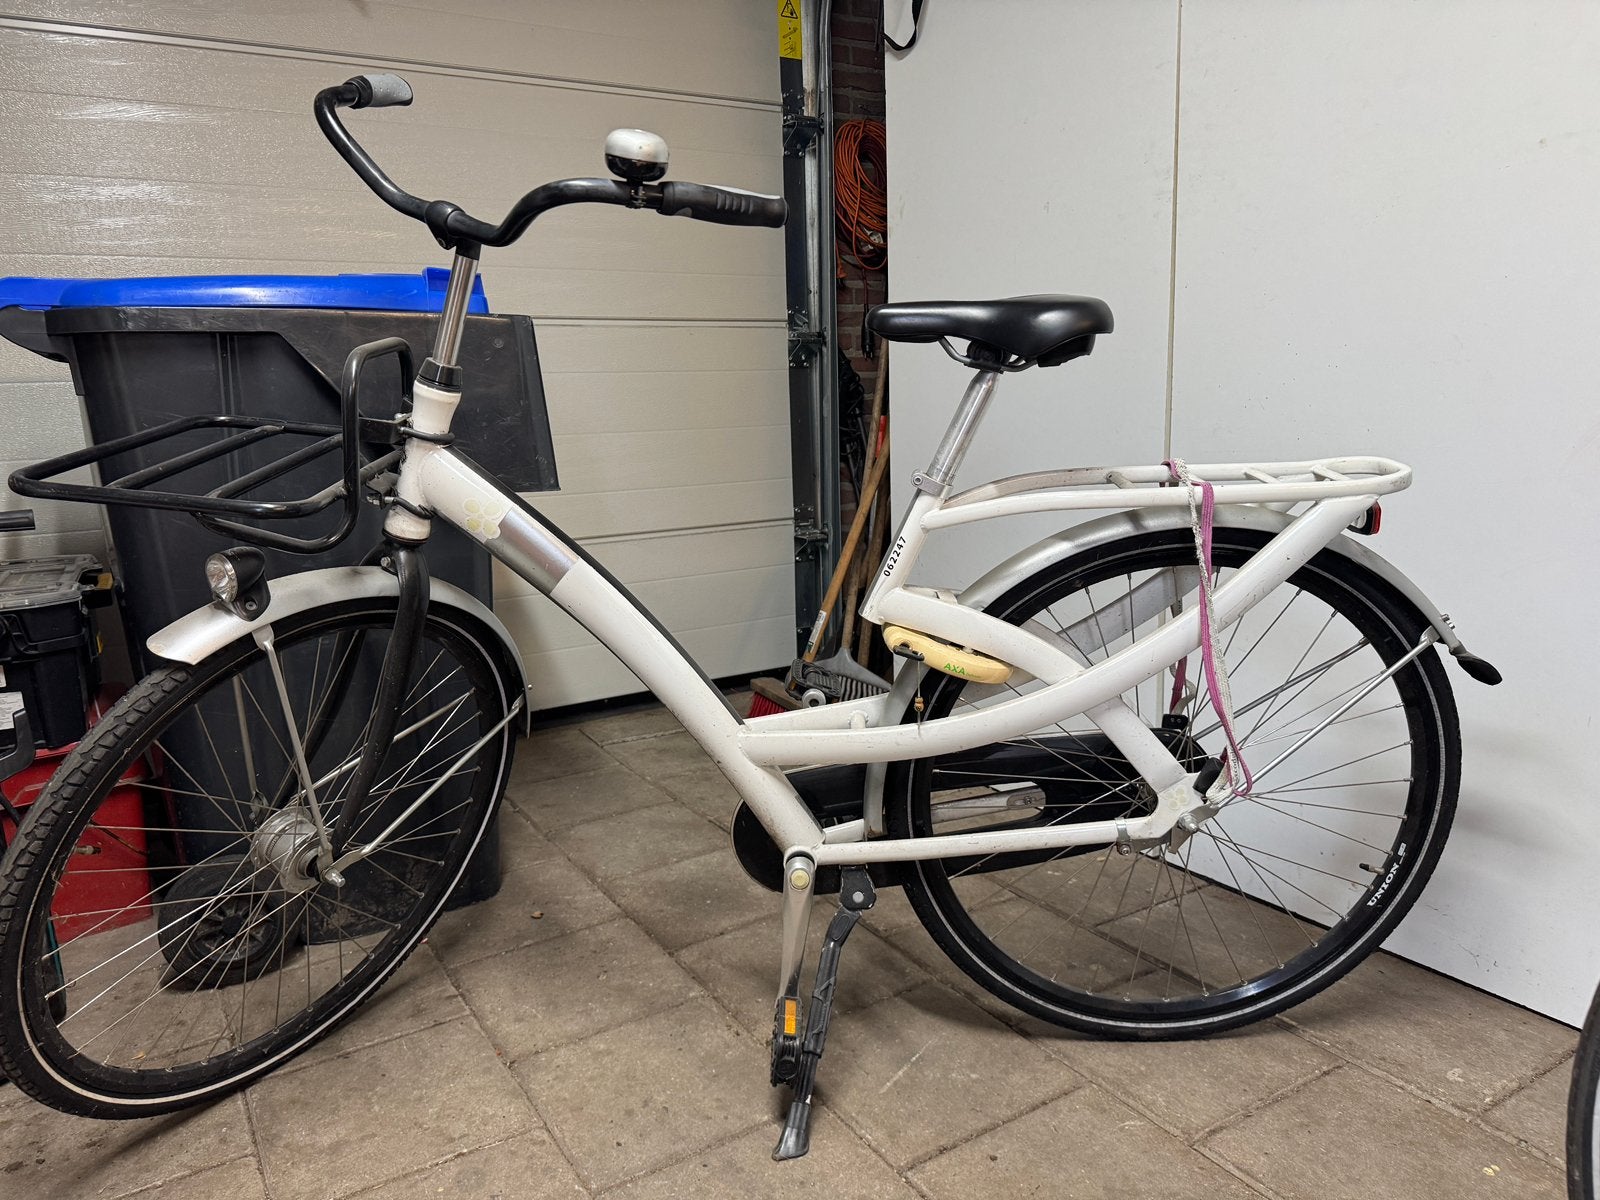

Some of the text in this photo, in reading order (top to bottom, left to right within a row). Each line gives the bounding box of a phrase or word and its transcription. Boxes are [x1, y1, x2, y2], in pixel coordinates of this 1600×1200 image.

[883, 536, 906, 577] 062247
[944, 662, 966, 676] AXA
[1366, 862, 1400, 907] UNION
